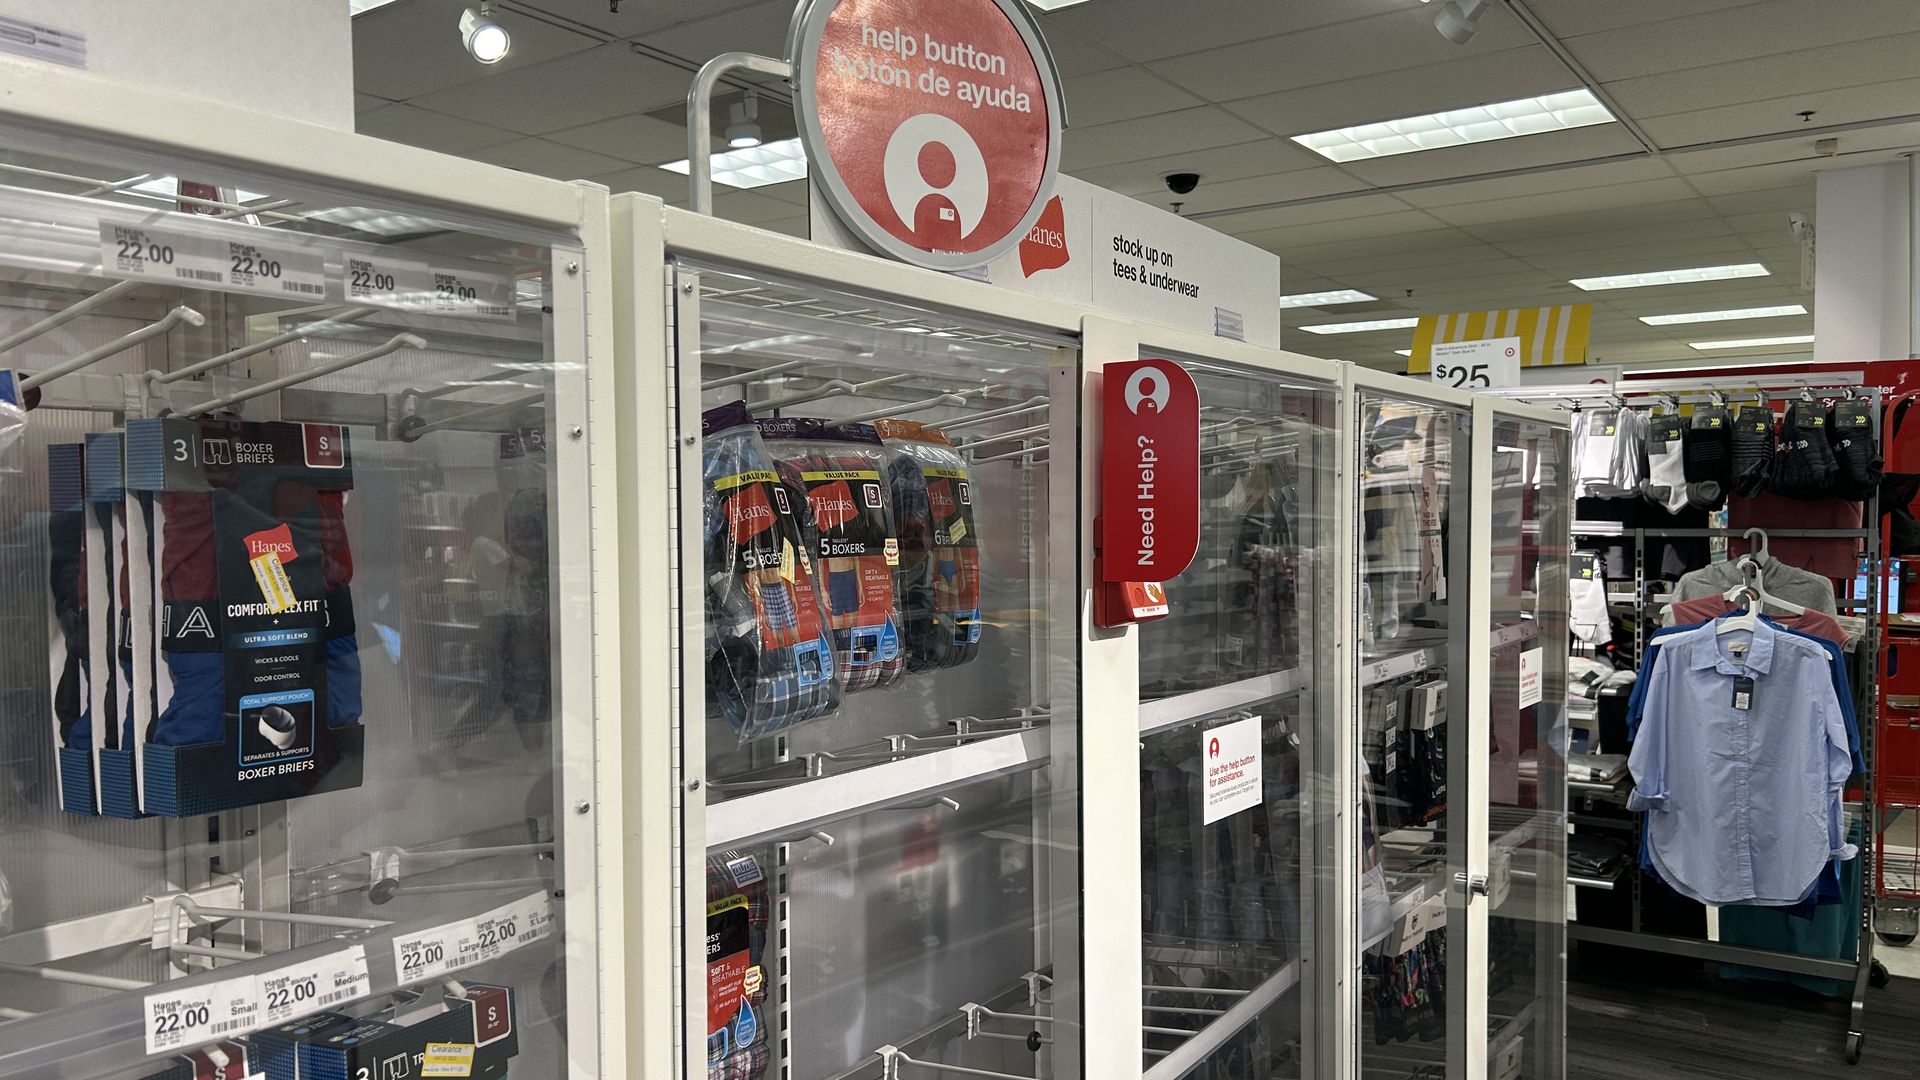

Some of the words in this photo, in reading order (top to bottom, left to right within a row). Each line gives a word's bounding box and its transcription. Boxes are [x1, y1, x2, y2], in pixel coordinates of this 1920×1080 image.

[861, 19, 918, 61] help
[924, 34, 1006, 76] button
[918, 69, 951, 97] de
[956, 81, 1031, 113] ayuda
[117, 240, 174, 265] 22.00
[1113, 234, 1143, 259] stock
[1146, 246, 1158, 267] up
[1161, 252, 1173, 267] on
[231, 255, 281, 279] 22.00
[351, 271, 394, 291] 22.00
[1113, 258, 1137, 281] tees
[1139, 266, 1148, 285] &
[1149, 271, 1200, 299] underwear
[1436, 364, 1490, 388] $25
[763, 422, 797, 432] BOXERS
[173, 438, 188, 462] 3
[236, 442, 273, 454] BOXER
[319, 436, 329, 450] S
[236, 453, 275, 464] BRIEFS
[1137, 435, 1158, 500] Help?
[870, 489, 876, 499] S
[816, 497, 852, 511] Hanes
[934, 530, 942, 545] 6
[1137, 507, 1155, 566] Need
[251, 541, 291, 554] Hanes
[820, 538, 831, 556] 5
[832, 543, 865, 555] BOXERS
[742, 549, 757, 569] 5
[271, 559, 289, 593] Clearance
[227, 600, 302, 617] COMFORLEX
[303, 600, 319, 613] FIT
[286, 632, 308, 640] BLEND
[279, 654, 299, 662] COOLS
[273, 672, 301, 681] CONTROL
[261, 695, 287, 704] SUPPORT
[288, 692, 309, 700] POUCH
[243, 752, 275, 762] SEPARATES
[280, 746, 310, 757] SUPPORTS
[238, 766, 275, 781] BOXER
[278, 760, 315, 775] BRIEFS
[1209, 766, 1220, 777] Use
[1220, 763, 1228, 773] the
[1229, 760, 1239, 770] help
[1240, 755, 1256, 767] button
[1209, 778, 1217, 788] for
[1217, 769, 1245, 785] assistance.
[714, 900, 730, 910] VALUE
[730, 896, 742, 905] PACK
[530, 919, 535, 927] X
[536, 913, 554, 924] Large
[479, 922, 516, 949] 22.00
[460, 942, 480, 953] Large
[402, 945, 443, 970] 22.00
[711, 964, 725, 977] SOFT
[712, 965, 746, 986] BREATHABLE
[334, 972, 368, 987] Medium
[267, 980, 316, 1010] 22.00
[231, 1002, 258, 1016] Small
[488, 1006, 497, 1022] S
[155, 1007, 209, 1035] 22.00
[355, 1067, 369, 1080] 3
